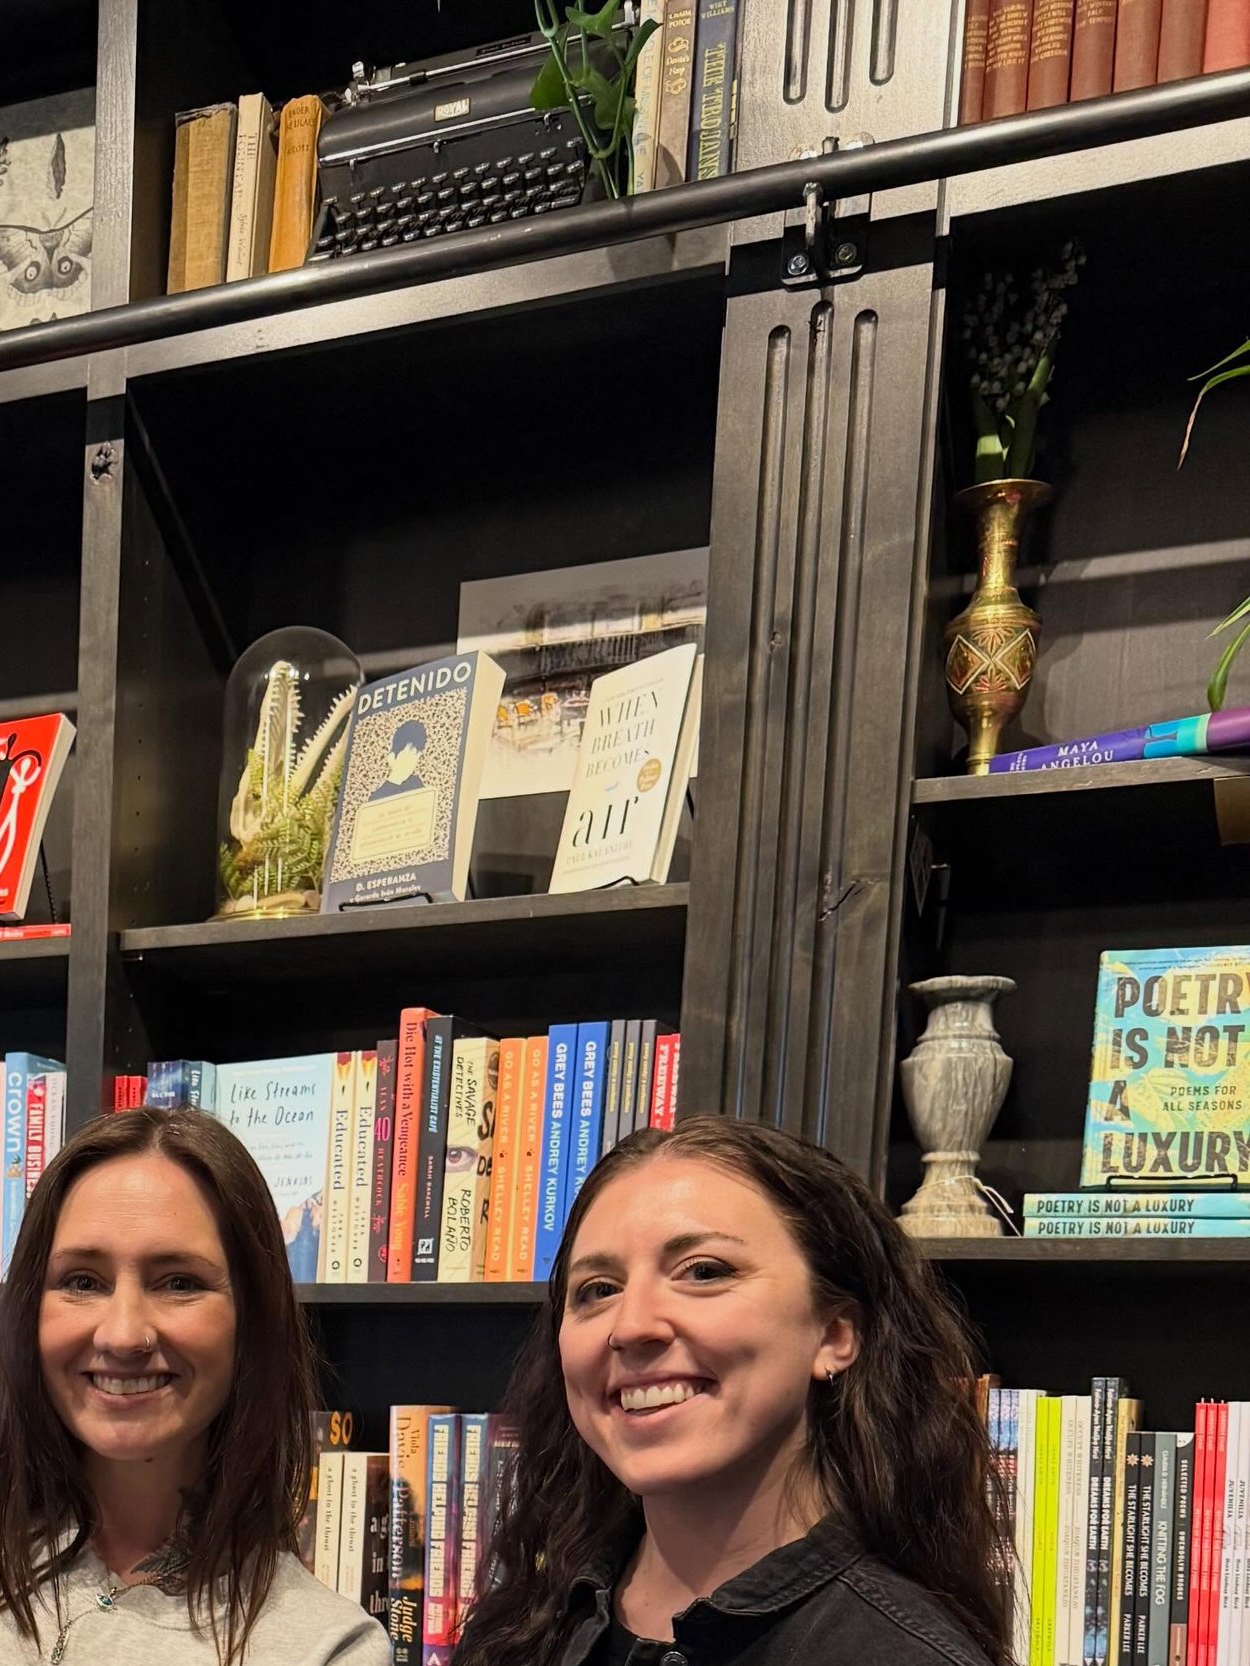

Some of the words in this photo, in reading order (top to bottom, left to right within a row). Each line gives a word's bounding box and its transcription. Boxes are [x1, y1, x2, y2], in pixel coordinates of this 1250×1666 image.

[436, 99, 470, 120] ROYAL
[698, 87, 724, 180] TROJANS
[356, 660, 473, 715] DETENIDO
[599, 690, 662, 728] WHEN
[591, 718, 655, 755] BREATH
[1057, 740, 1100, 757] MAYA
[1040, 750, 1115, 772] ANGELOU
[572, 796, 639, 848] air
[366, 872, 417, 890] ESPERANZA
[405, 1022, 417, 1042] Die
[1110, 1027, 1149, 1070] IS
[1164, 1024, 1245, 1069] NOT
[404, 1046, 416, 1069] Hot
[554, 1042, 568, 1080] GREY
[583, 1041, 597, 1079] GREY
[230, 1084, 256, 1104] Like
[266, 1080, 317, 1100] Streams
[402, 1072, 414, 1100] with
[429, 1060, 441, 1114] EXISTENTIALIST
[455, 1056, 464, 1118] DETECTIVES
[465, 1079, 478, 1126] SAVAGE
[551, 1082, 564, 1119] BEES
[580, 1081, 594, 1118] BEES
[1104, 1080, 1131, 1122] A
[1170, 1086, 1210, 1097] POEMS
[1214, 1085, 1237, 1096] FOR
[7, 1071, 23, 1154] crown
[28, 1102, 44, 1142] FAMILY
[246, 1108, 267, 1127] the
[274, 1106, 314, 1126] Ocean
[1162, 1101, 1184, 1112] ALL
[1188, 1100, 1242, 1112] SEASONS
[355, 1106, 372, 1188] Educated
[374, 1116, 391, 1142] 40
[398, 1111, 413, 1177] Vengeance
[576, 1120, 590, 1173] ANDREY
[332, 1109, 349, 1191] Educated
[547, 1122, 563, 1175] ANDREY
[375, 1147, 385, 1207] HEATHCOCK
[460, 1188, 471, 1252] ROBERTO
[543, 1178, 558, 1232] KURKOV
[1037, 1199, 1083, 1213] POETRY
[1088, 1199, 1101, 1213] IS
[1104, 1198, 1129, 1213] NOT
[1145, 1198, 1195, 1213] LUXURY
[1038, 1221, 1084, 1235] POETRY
[1089, 1221, 1101, 1235] IS
[1105, 1220, 1130, 1235] NOT
[1146, 1220, 1195, 1234] LUXURY
[1089, 1476, 1099, 1509] DREAMS
[1101, 1476, 1112, 1509] DREAMS
[1127, 1484, 1136, 1500] THE
[1142, 1485, 1151, 1501] THE
[1180, 1459, 1188, 1494] SELECTED
[1126, 1500, 1136, 1544] STARLIGHT
[1141, 1501, 1151, 1546] STARLIGHT
[1179, 1495, 1187, 1519] POEMS
[392, 1485, 409, 1580] Patterson
[1088, 1526, 1097, 1550] EARTH
[1100, 1526, 1110, 1550] EARTH
[1156, 1520, 1167, 1564] KNITTING
[1177, 1530, 1185, 1572] GWENDOLYN
[1125, 1544, 1134, 1559] SHE
[1140, 1546, 1149, 1560] SHE
[1124, 1560, 1133, 1596] BECOMES
[1139, 1561, 1148, 1597] BECOMES
[1156, 1565, 1166, 1582] THE
[1176, 1573, 1184, 1601] BROOKS
[1155, 1584, 1165, 1605] FOG
[390, 1597, 400, 1640] Stone
[400, 1596, 418, 1643] Judge
